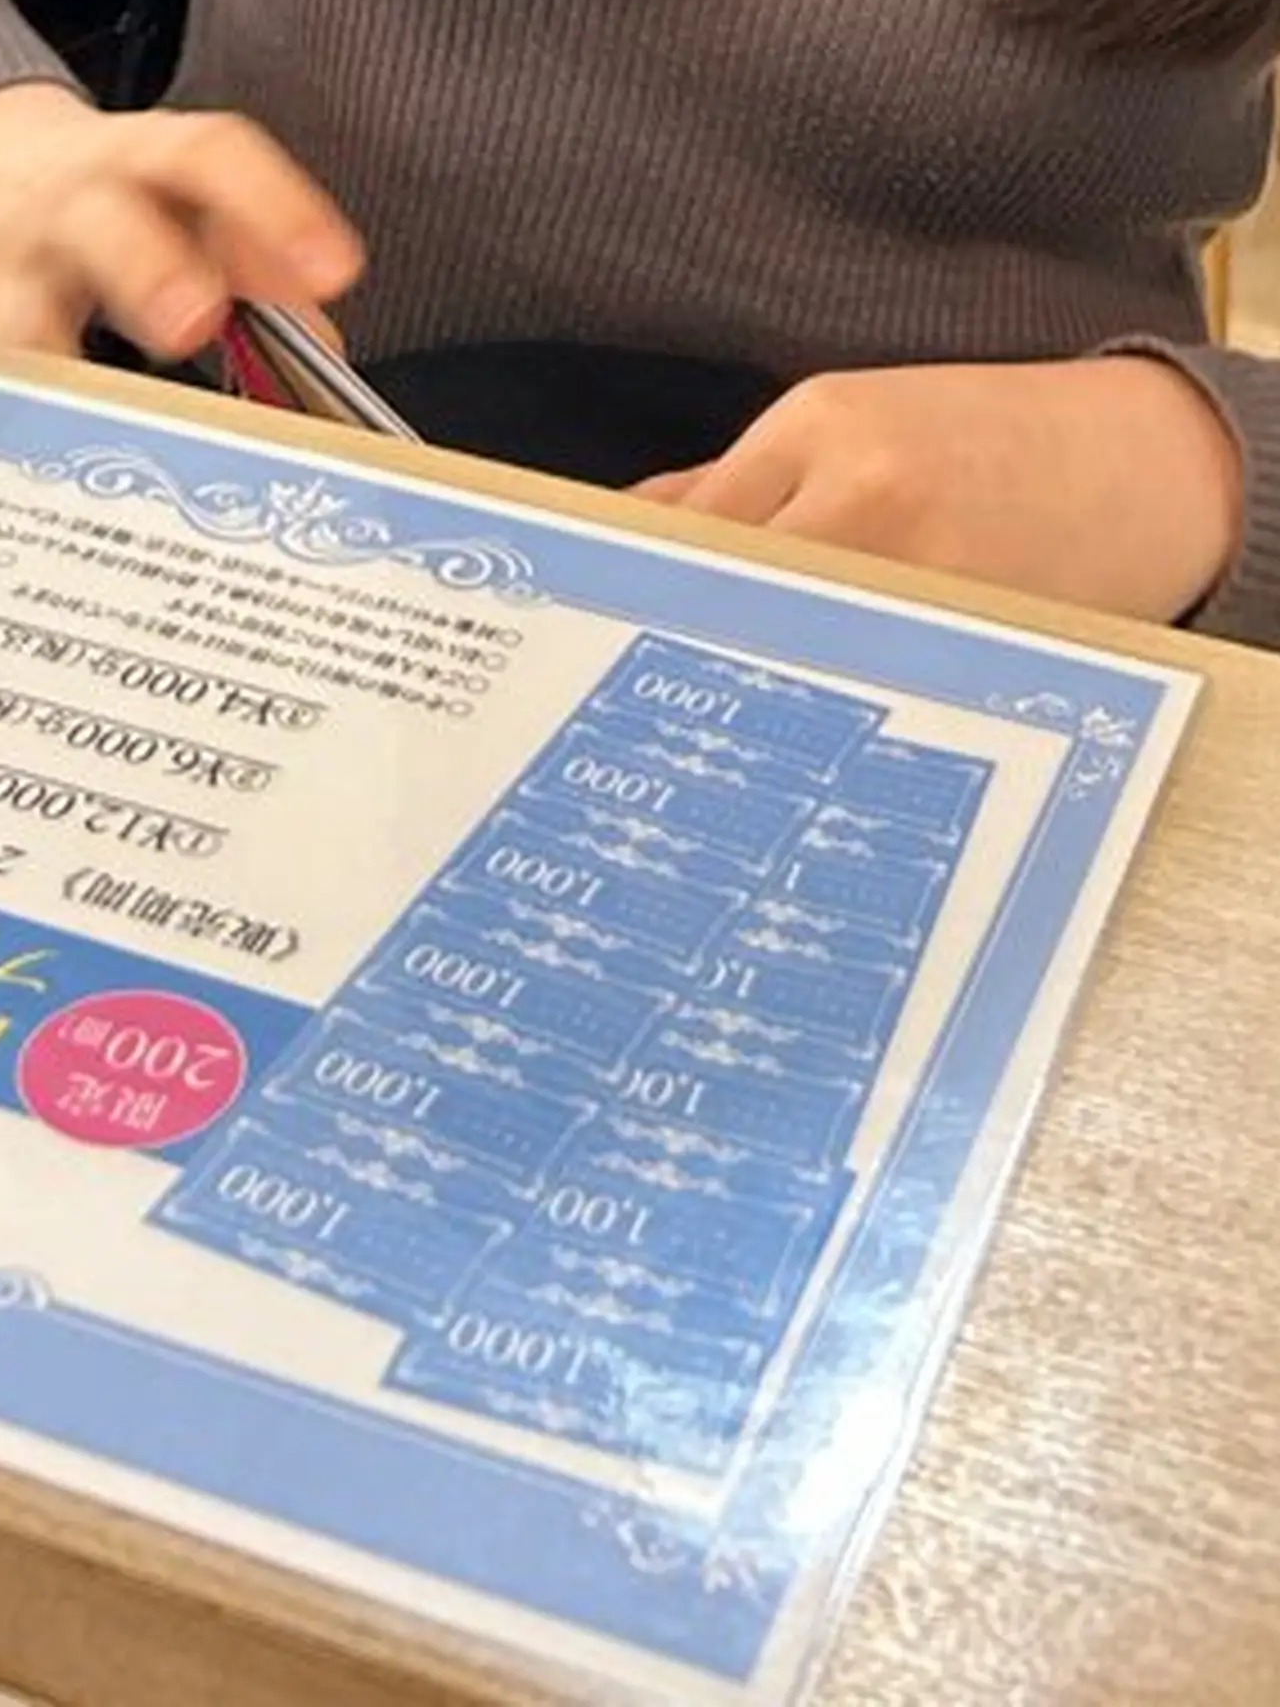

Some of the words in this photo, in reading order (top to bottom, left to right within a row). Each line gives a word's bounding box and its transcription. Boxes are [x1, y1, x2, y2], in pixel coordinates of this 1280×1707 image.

[631, 671, 743, 725] 1,000
[561, 753, 678, 813] 1,000
[484, 845, 607, 907] 1,000
[402, 942, 526, 1009] 1,000
[53, 1069, 167, 1131] 限定
[311, 1046, 443, 1121] 1,000
[214, 1160, 353, 1239] 1,000
[532, 1179, 654, 1244] 1,00
